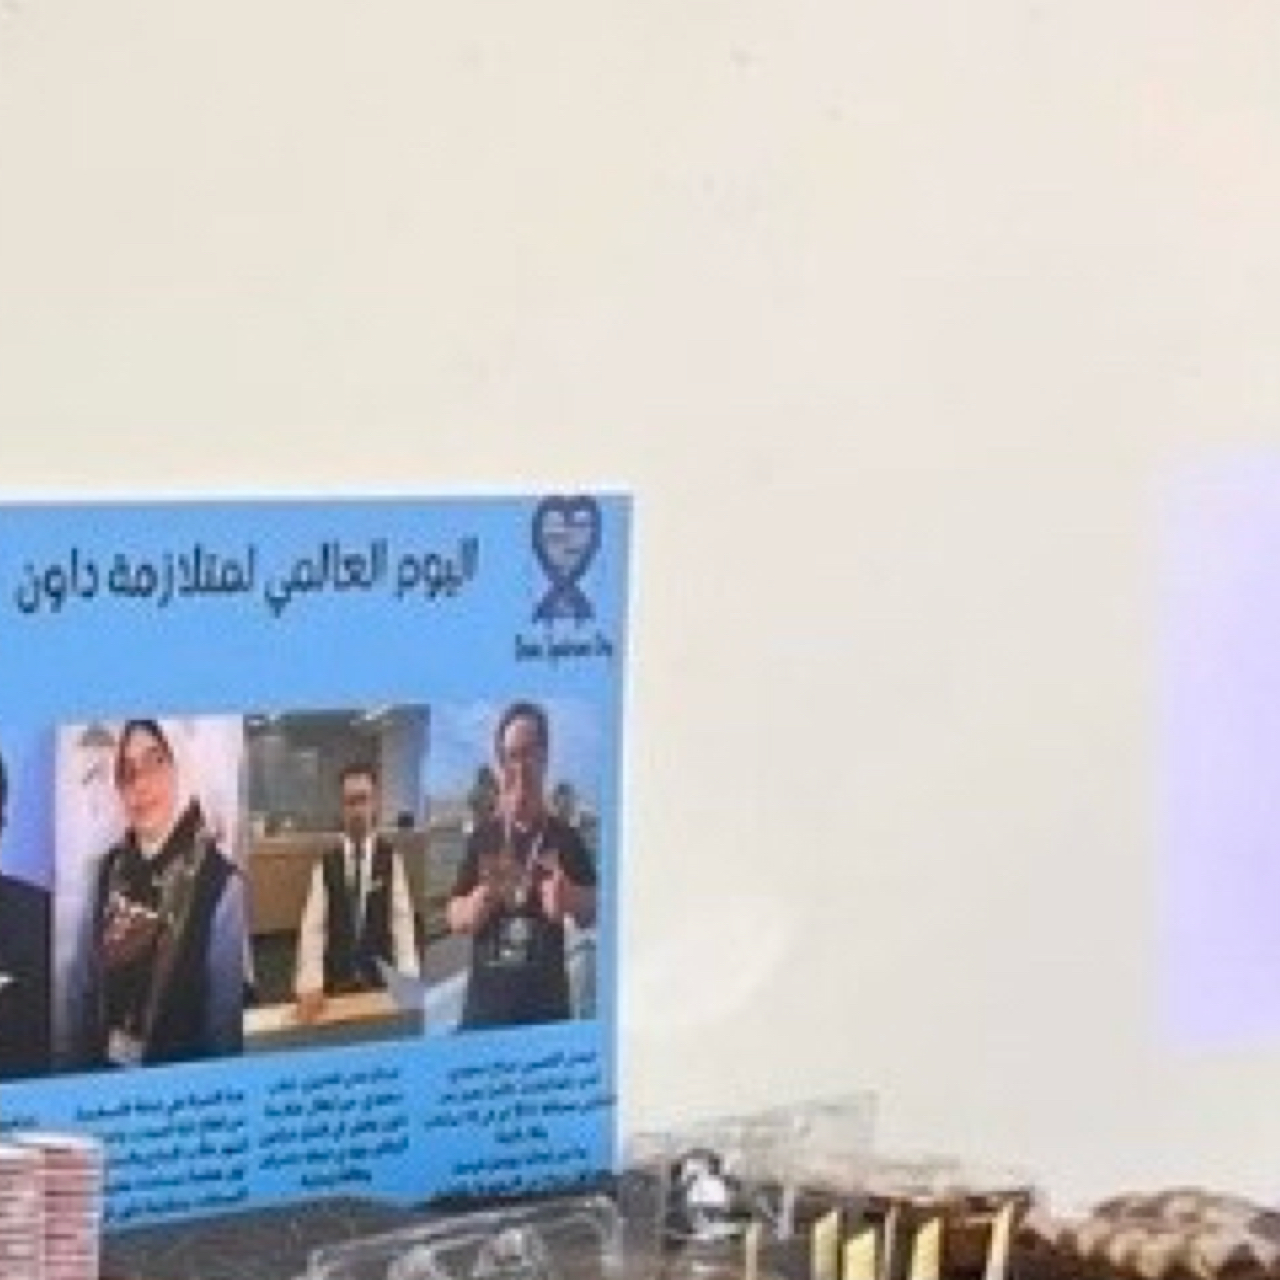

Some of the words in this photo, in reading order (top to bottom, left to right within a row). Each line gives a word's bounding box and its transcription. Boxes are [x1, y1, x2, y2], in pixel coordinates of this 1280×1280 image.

[13, 548, 100, 614] داون
[105, 542, 257, 608] لمتلازمة
[262, 536, 388, 618] العالمي
[393, 534, 481, 602] اليوم
